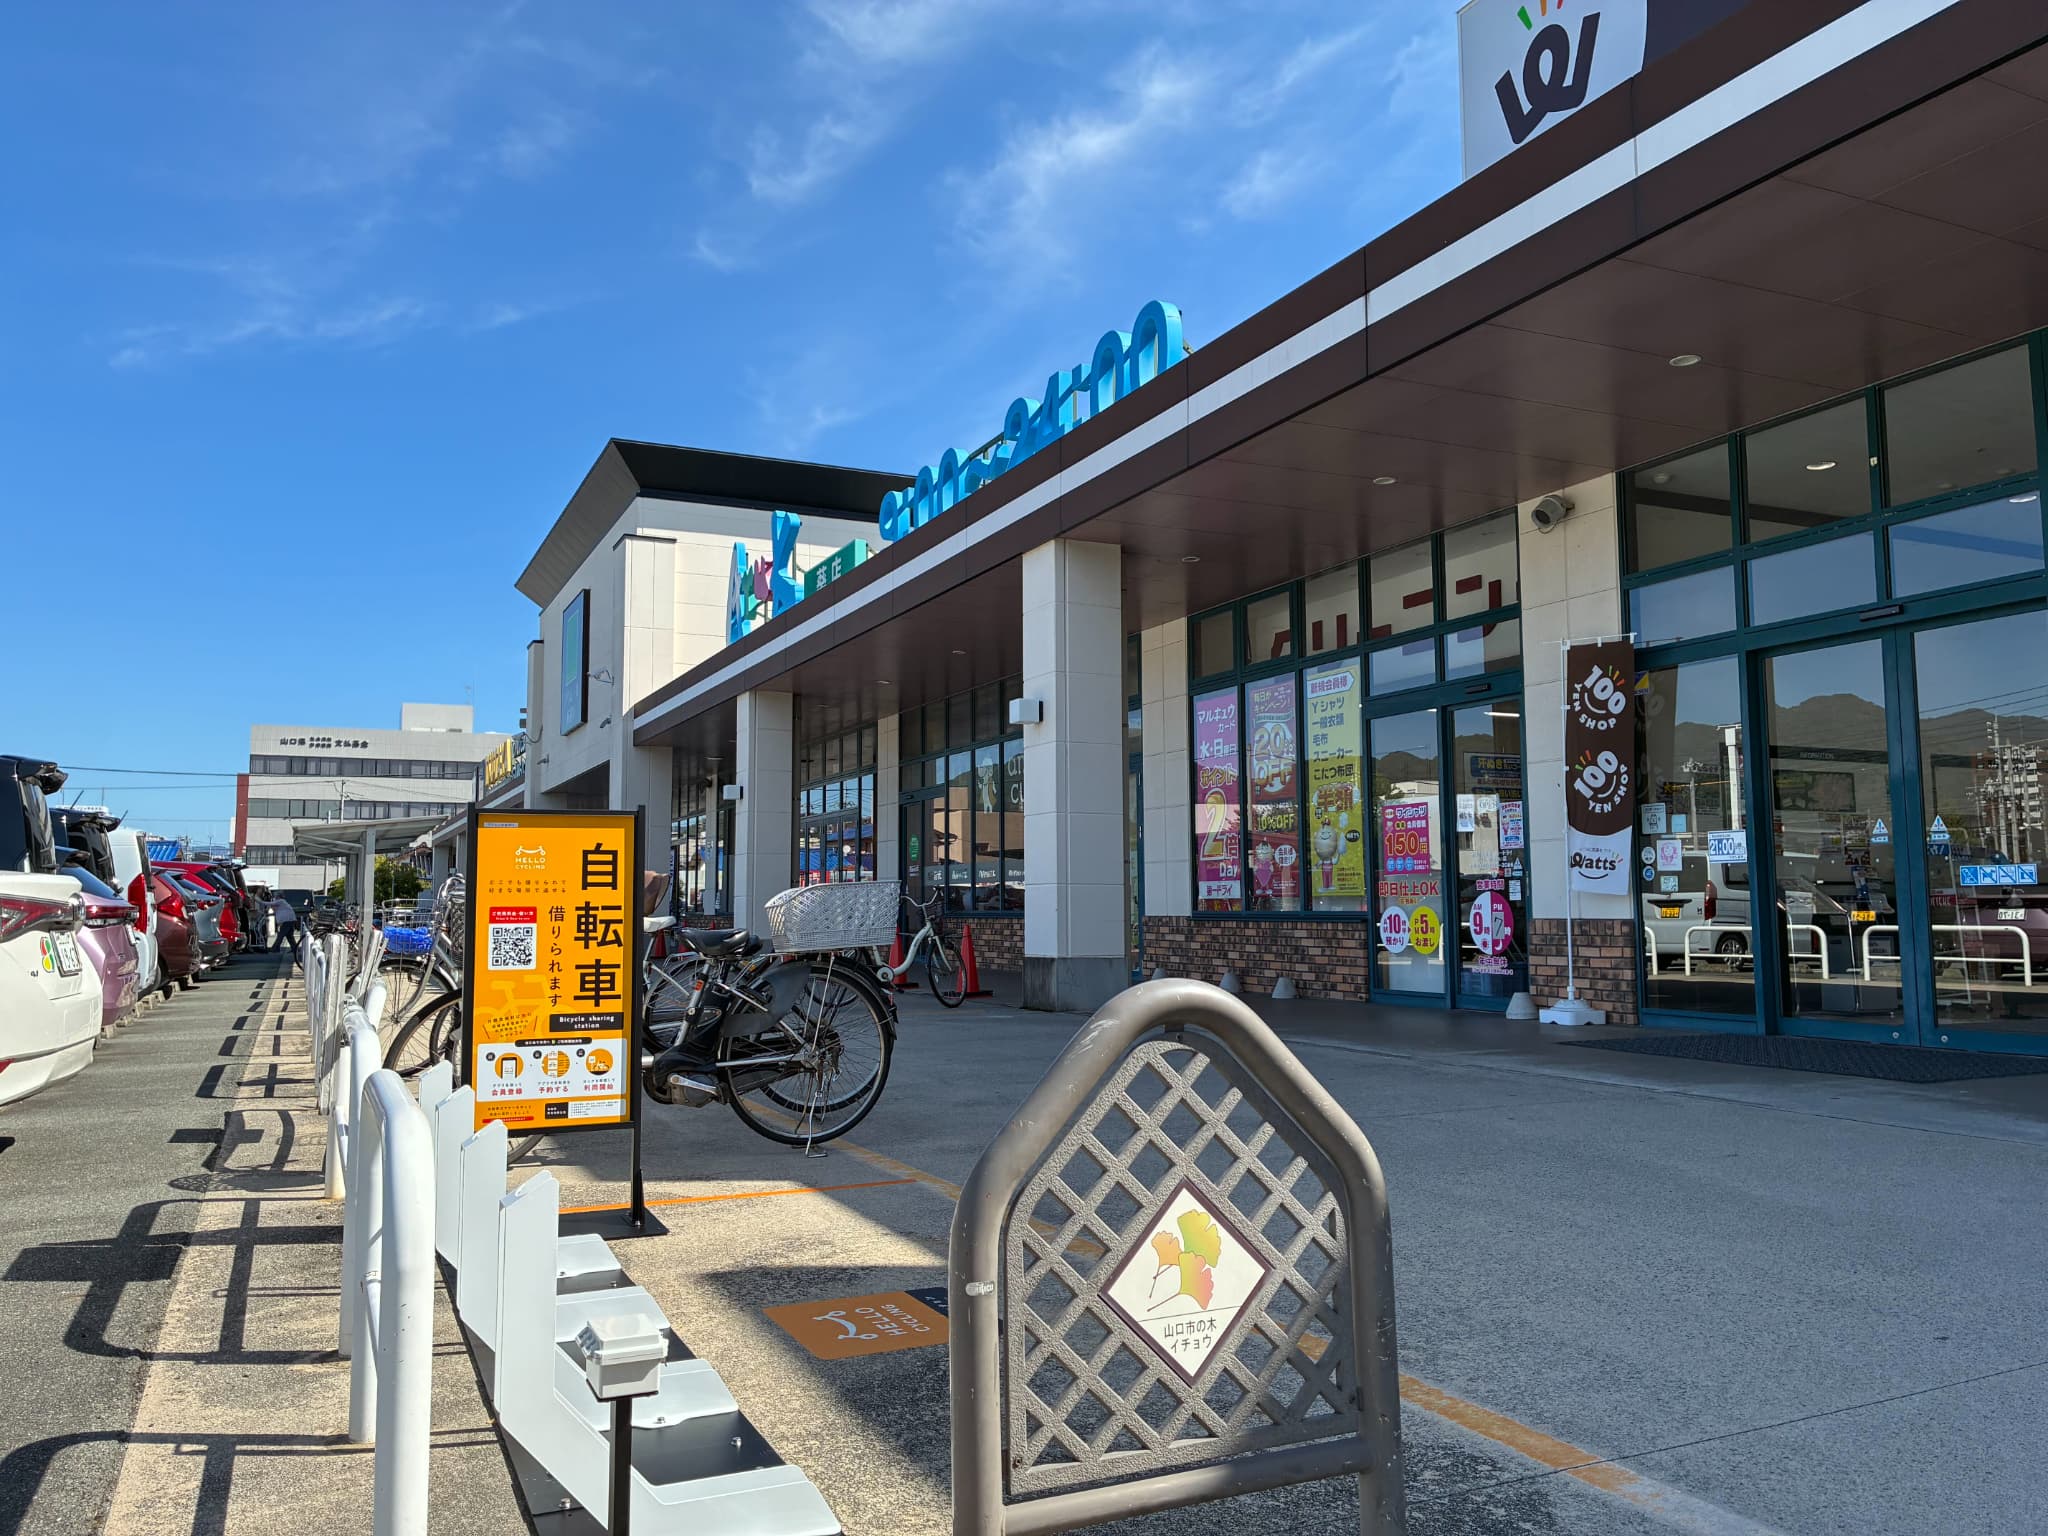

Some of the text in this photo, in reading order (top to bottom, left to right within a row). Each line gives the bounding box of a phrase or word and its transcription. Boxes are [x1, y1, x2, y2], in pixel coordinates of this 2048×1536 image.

[1584, 665, 1627, 715] 100
[1197, 703, 1235, 724] マルキュウ
[1573, 683, 1617, 730] YEN SHOP
[1217, 719, 1236, 734] カード
[1312, 732, 1329, 747] 毛布
[1313, 747, 1354, 763] スニーカー
[1200, 762, 1238, 788] ポイント
[1313, 763, 1355, 781] こたつ布団
[1574, 750, 1618, 798] 100
[1588, 763, 1629, 814] YEN SHOP
[1385, 831, 1419, 856] 150
[1709, 838, 1735, 855] 21:00
[1219, 862, 1238, 878] Day
[1379, 880, 1440, 897] 即日仕上OK
[574, 843, 623, 1008] 自転車
[548, 905, 566, 1008] 借りられます
[559, 1014, 615, 1024] Bicycle sharing
[538, 1085, 569, 1094] 予約する
[1164, 1316, 1217, 1338] 山口市の木
[1170, 1334, 1213, 1354] イチョウ
